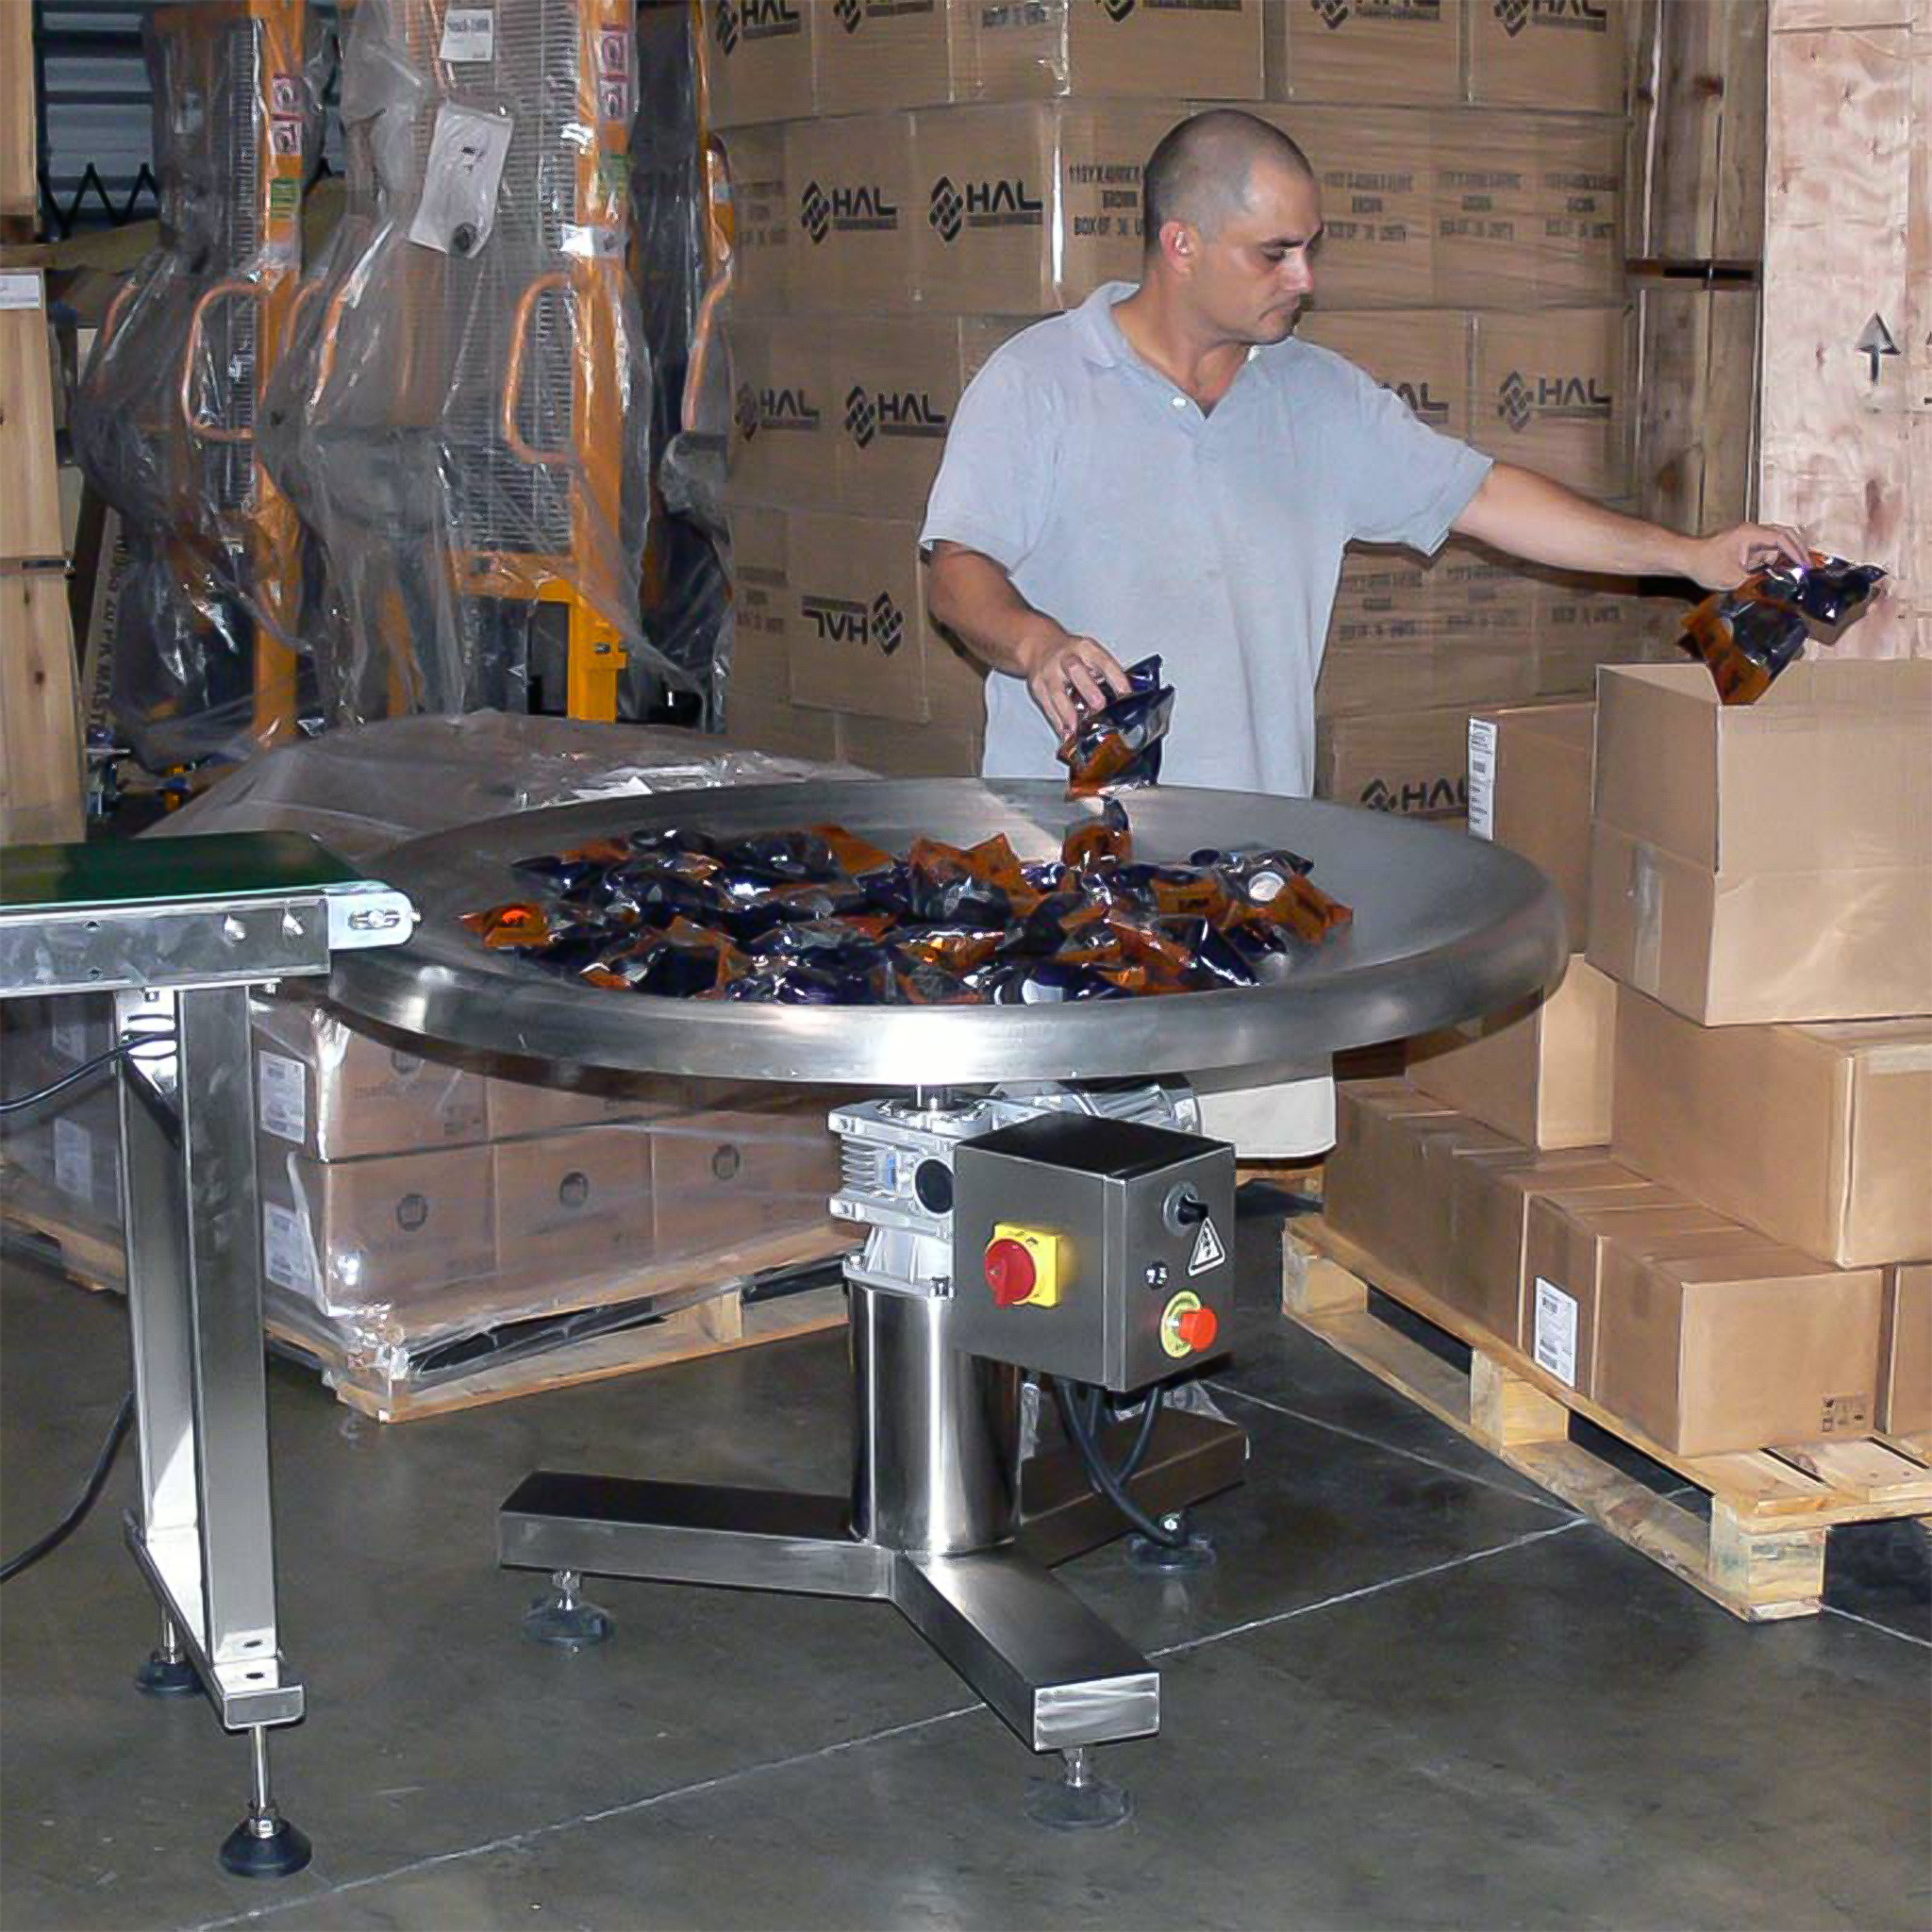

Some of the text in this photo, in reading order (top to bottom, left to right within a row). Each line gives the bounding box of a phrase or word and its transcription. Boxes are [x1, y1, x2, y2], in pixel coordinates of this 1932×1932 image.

[741, 0, 799, 26] HAL
[832, 187, 897, 217] HAL
[966, 180, 1042, 213] HAL
[759, 389, 819, 416] HAL
[1383, 382, 1449, 410] AL
[1539, 376, 1611, 406] HAL
[877, 392, 946, 423] HAL
[802, 608, 868, 645] HAL
